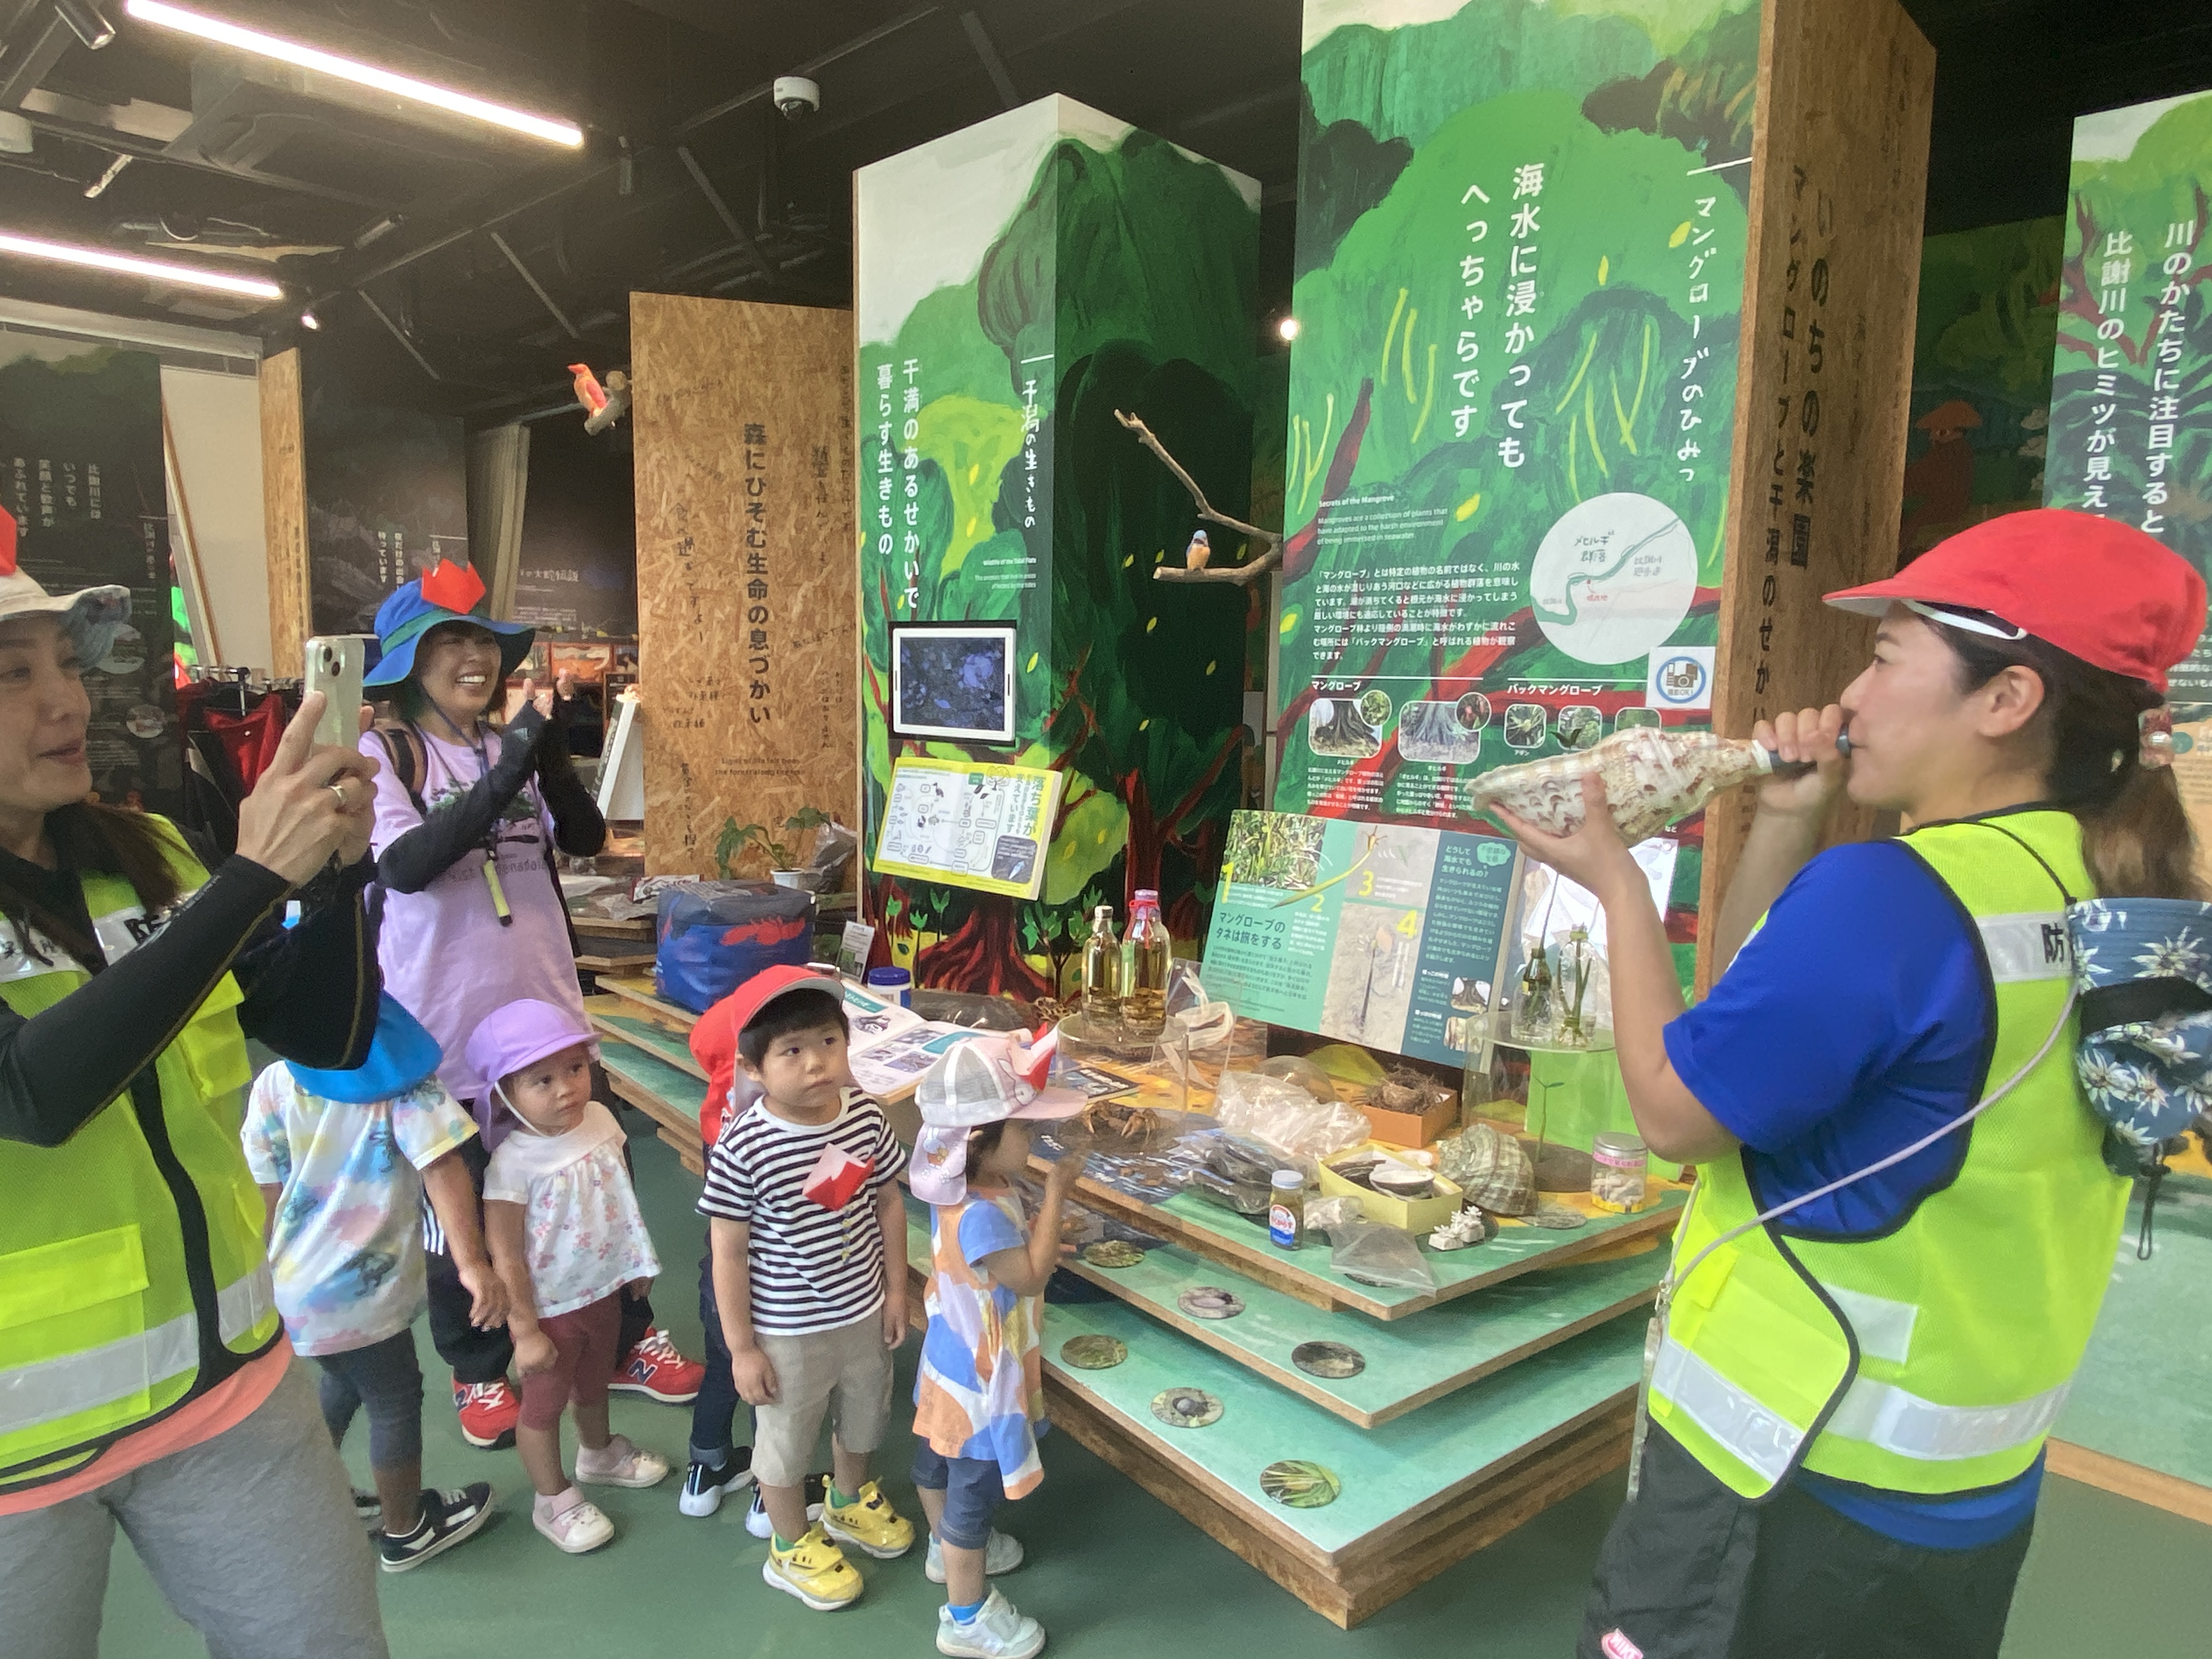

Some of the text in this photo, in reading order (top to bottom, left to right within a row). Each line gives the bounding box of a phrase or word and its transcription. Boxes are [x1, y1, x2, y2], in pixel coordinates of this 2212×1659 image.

[1451, 185, 1490, 437] へっちゃらです
[1498, 163, 1545, 469] 海水に浸かっても
[1677, 196, 1717, 482] マングローブのひみつ
[2082, 230, 2132, 518] 比謝川のヒミツが見え
[2140, 220, 2194, 534] 川のかたちに注目すると
[877, 363, 894, 555] 暮らす生きもの
[1020, 380, 1040, 528] 干潟の生きもの
[902, 358, 920, 609] 干満のあるせかいで
[1318, 499, 1341, 507] Secrets
[1361, 495, 1395, 504] Mangrove
[1318, 516, 1352, 524] Mangroves
[1369, 512, 1402, 520] collection
[1411, 510, 1432, 518] plants
[1333, 525, 1359, 534] adapted
[1400, 520, 1443, 528] environment
[1344, 535, 1376, 543] immersed
[743, 422, 770, 724] 森にひそむ生命の息づかい
[1312, 651, 1344, 661] できます。
[1312, 680, 1362, 692] マングローブ
[1507, 684, 1602, 696] バックマングローブ
[1023, 775, 1047, 836] 落ち葉が
[1443, 855, 1472, 866] 海水でも
[1446, 845, 1471, 856] どうして
[1221, 862, 1234, 904] 1
[1358, 870, 1374, 896] 3
[1311, 894, 1325, 912] 2
[1220, 912, 1285, 933] マングローブの
[1396, 909, 1418, 939] 4
[1216, 927, 1282, 950] タネは旅をする
